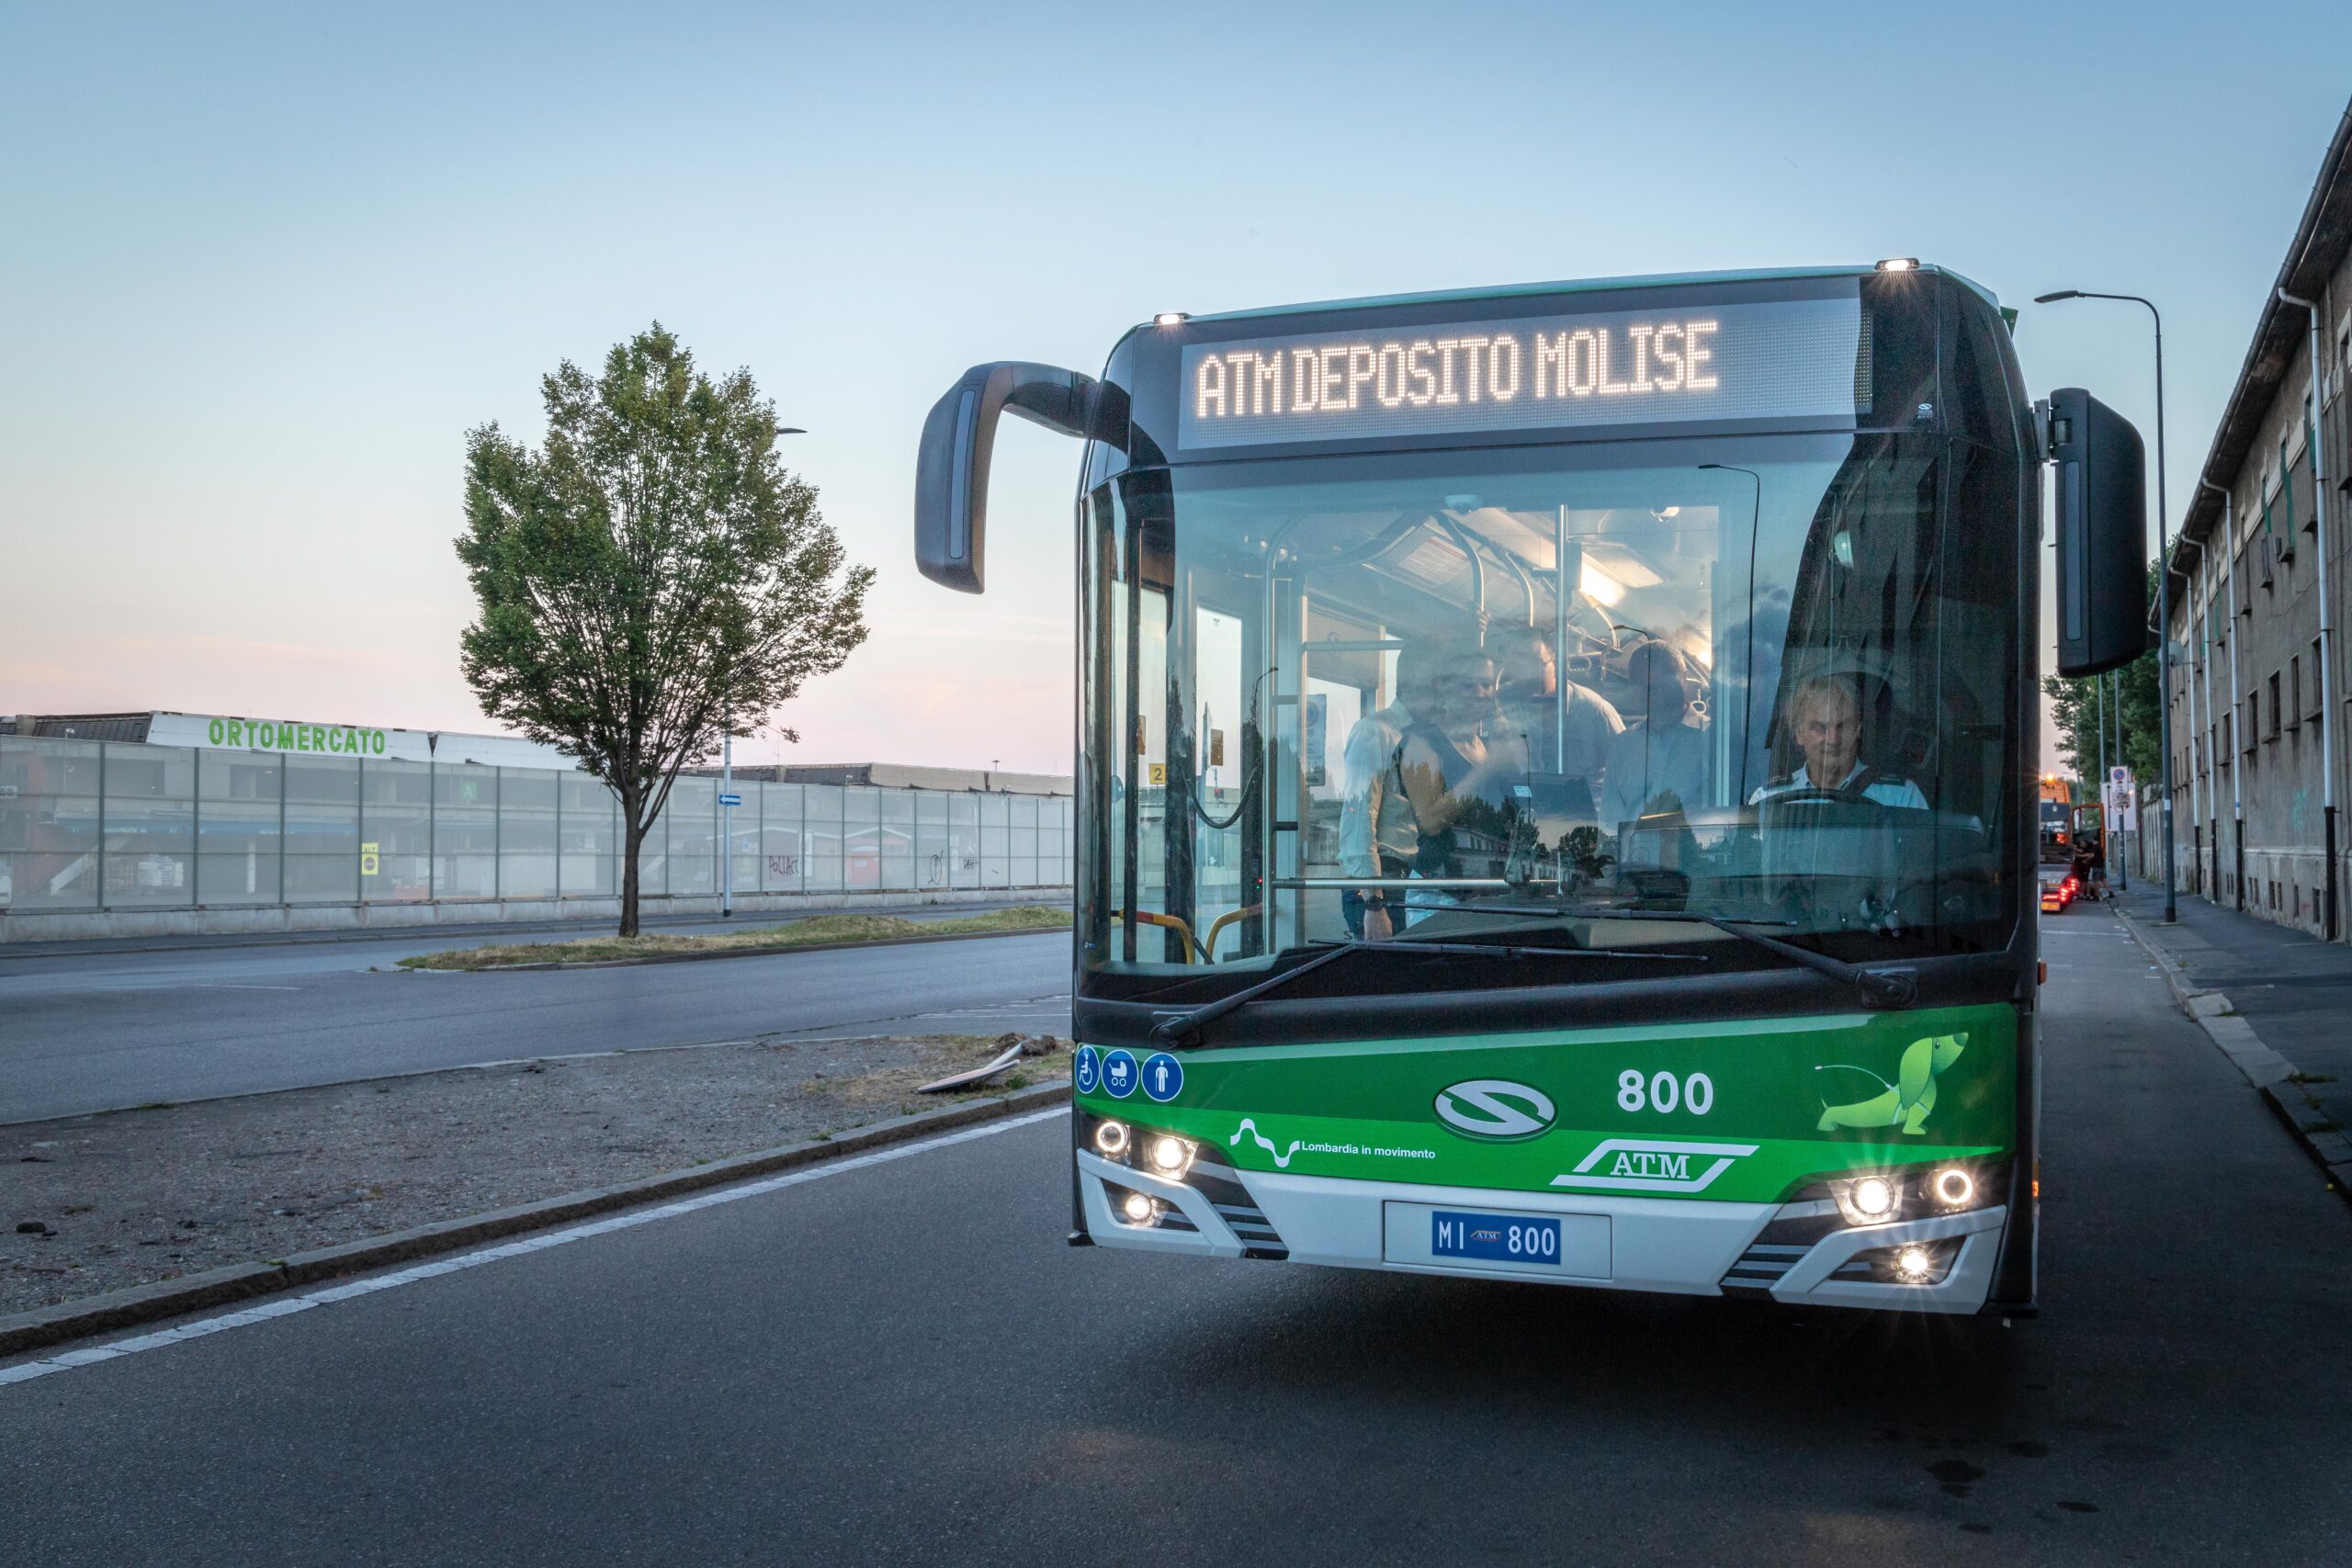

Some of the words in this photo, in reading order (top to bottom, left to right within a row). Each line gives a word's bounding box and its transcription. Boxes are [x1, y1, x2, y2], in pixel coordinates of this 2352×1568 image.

[1198, 350, 1282, 416] ATM
[1292, 335, 1519, 412] DEPOSITO
[1536, 321, 1718, 399] MOLISE
[209, 719, 385, 755] ORTOMERCATO
[1617, 1069, 1713, 1115] 800
[1301, 1141, 1359, 1155] Lombardia
[1362, 1145, 1372, 1155] in
[1374, 1146, 1436, 1159] movimento
[1610, 1151, 1690, 1179] ATM
[1439, 1221, 1464, 1249] MI
[1476, 1232, 1497, 1240] ATM
[1508, 1225, 1555, 1256] 800
